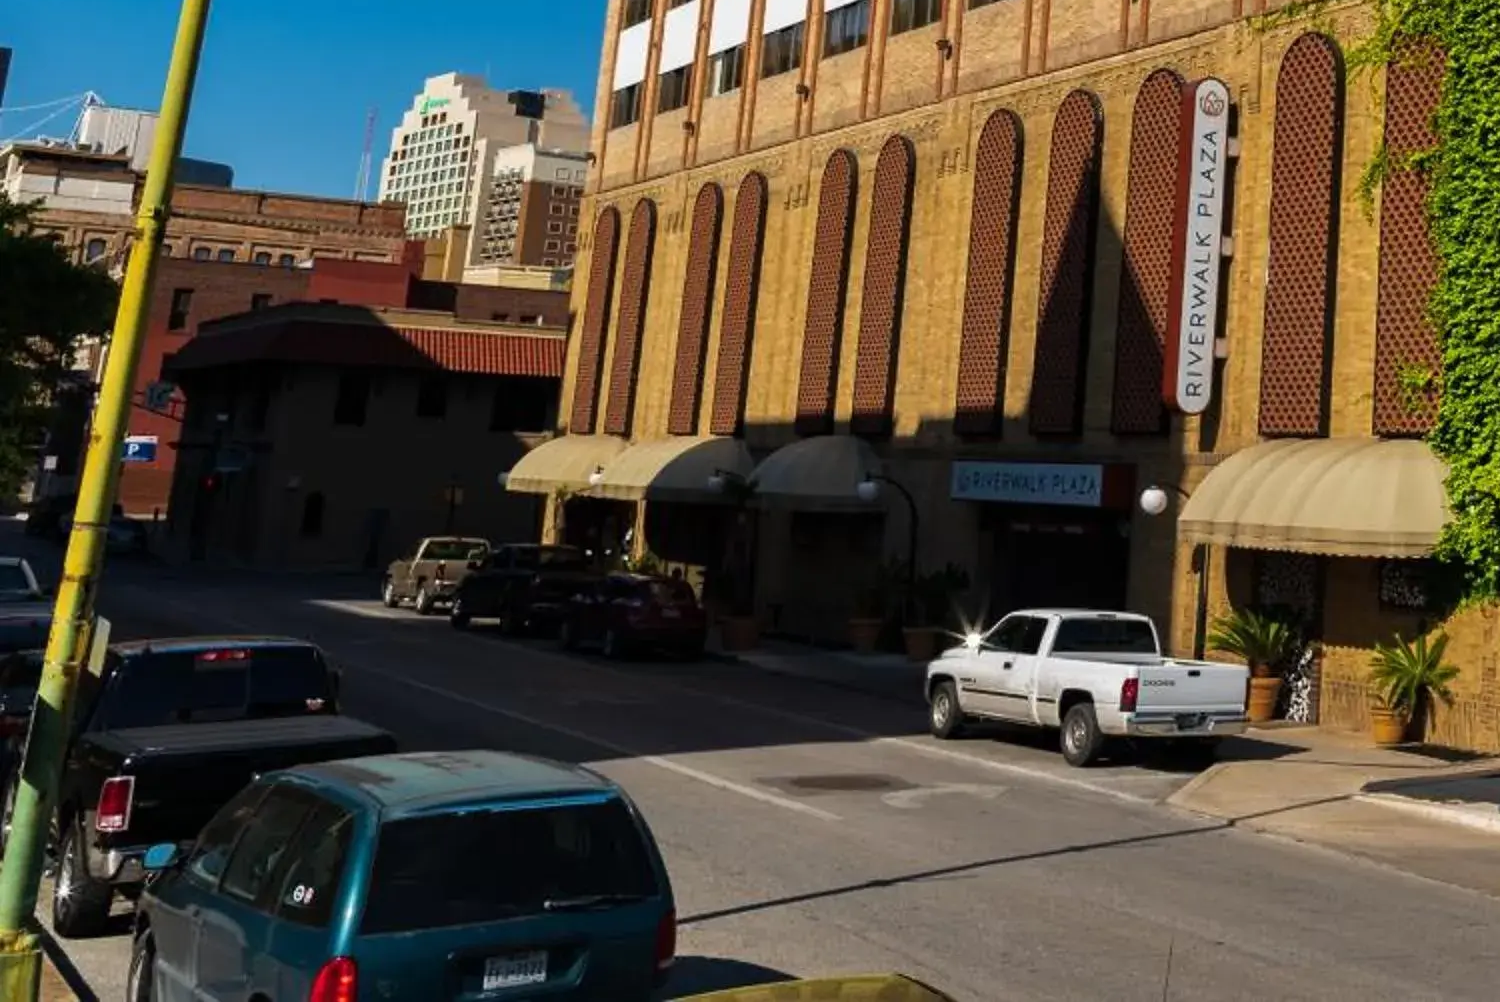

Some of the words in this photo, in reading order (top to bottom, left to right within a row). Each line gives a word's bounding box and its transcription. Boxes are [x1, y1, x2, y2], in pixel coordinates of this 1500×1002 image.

[1197, 130, 1217, 218] PLAZA
[1185, 231, 1211, 398] RIVERWALK
[127, 443, 141, 456] P
[973, 471, 1045, 494] RIVERWALK
[1052, 473, 1098, 496] PLAZA
